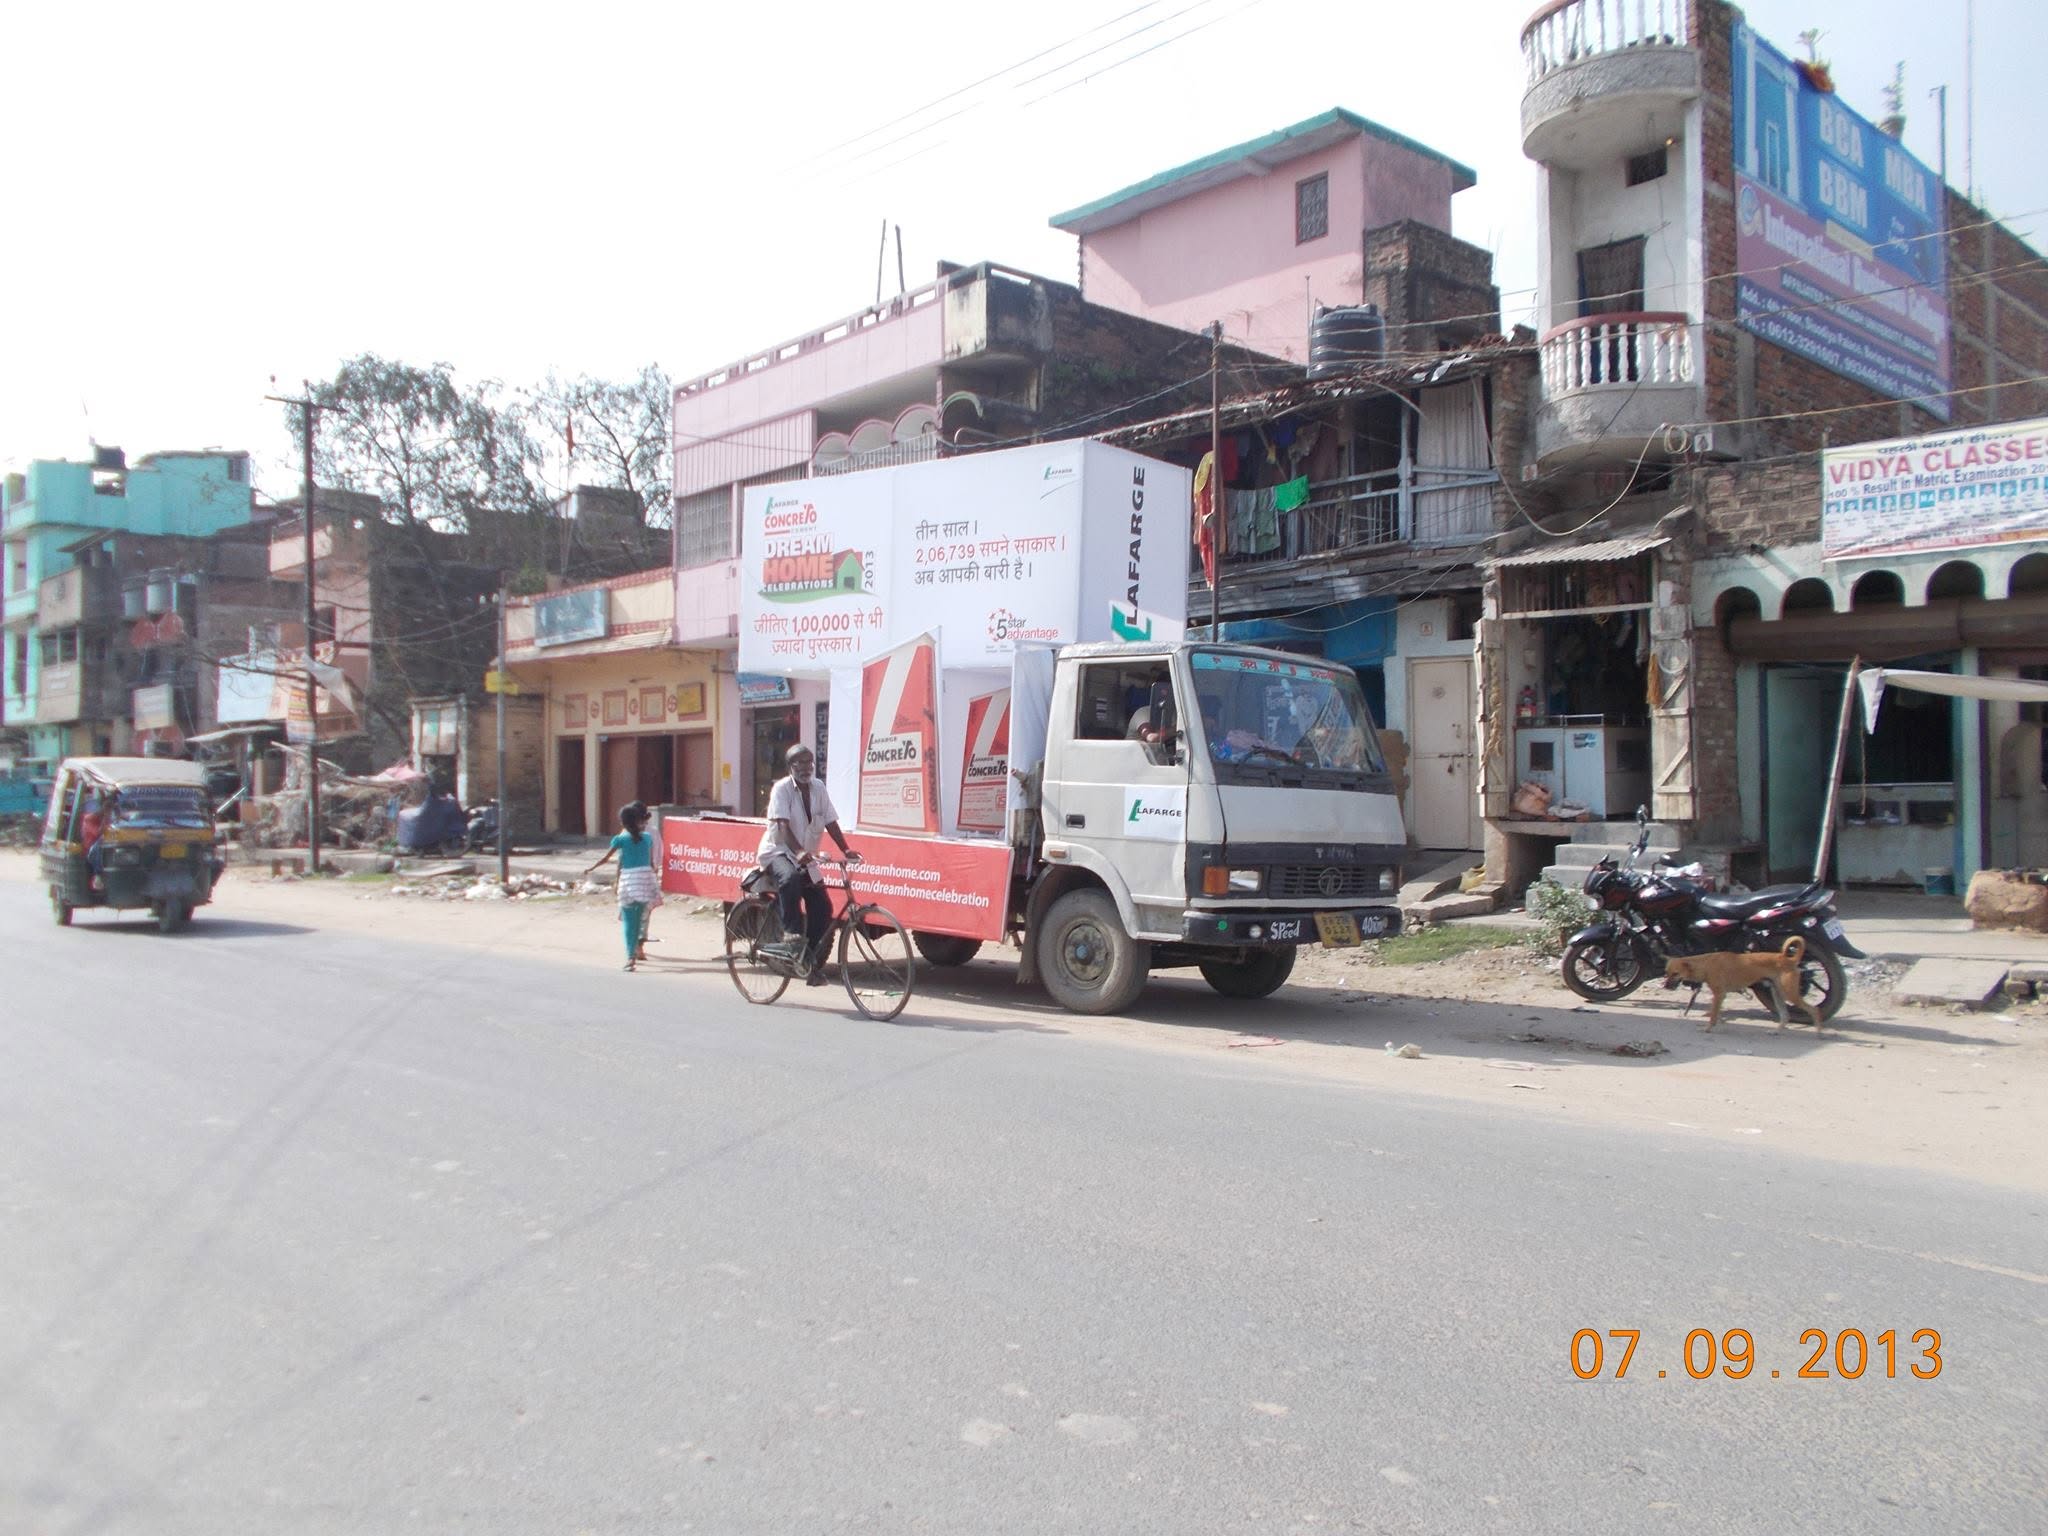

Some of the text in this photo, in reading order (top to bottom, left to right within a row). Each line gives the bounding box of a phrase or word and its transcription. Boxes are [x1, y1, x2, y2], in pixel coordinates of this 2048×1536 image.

[1820, 98, 1864, 168] BCA
[1885, 146, 1927, 212] MBA
[1820, 159, 1867, 229] BBM
[1829, 435, 2048, 485] VIDYA CLASSE
[1864, 478, 1897, 494] Result
[1901, 477, 1911, 489] in
[1915, 471, 1950, 487] Matric
[1955, 465, 2027, 483] Examination
[2032, 463, 2048, 475] 20
[764, 503, 817, 528] CONCRETO
[915, 520, 938, 541] तीन
[943, 520, 969, 538] साल
[764, 533, 833, 560] DREAM
[916, 544, 975, 567] 2,06,739
[979, 535, 1009, 557] सपने
[1014, 535, 1056, 555] साकार
[1126, 466, 1145, 625] LAFARGE
[763, 553, 834, 584] HOME
[865, 550, 874, 588] 2013
[915, 570, 935, 585] अब
[938, 561, 979, 584] आपकी
[984, 558, 1009, 580] बारी
[1014, 556, 1024, 580] है
[762, 578, 834, 592] CELEBRATIONS
[753, 606, 883, 636] जीतिए 1,00,000 से भी
[996, 617, 1026, 640] 5 star
[1007, 627, 1058, 641] advantage
[808, 637, 852, 659] पुरस्कार
[866, 740, 917, 763] CONCRETO
[968, 760, 1008, 777] CONCRETO
[669, 859, 684, 872] SMS
[685, 861, 717, 875] CEMENT
[670, 844, 684, 856] Toll
[684, 845, 700, 858] Free
[701, 847, 714, 859] No.
[720, 849, 739, 862] 1800
[739, 851, 754, 864] 345
